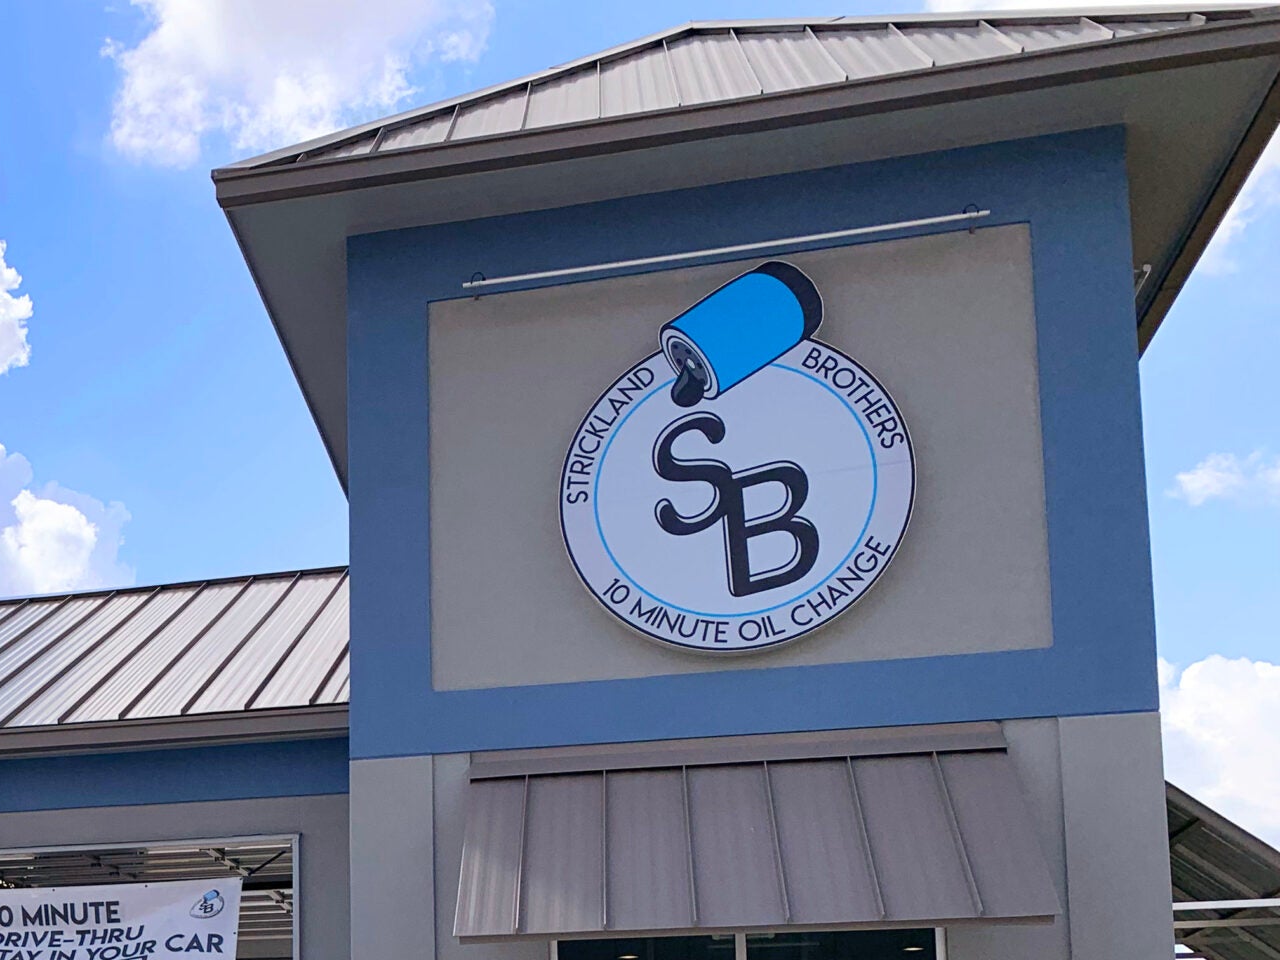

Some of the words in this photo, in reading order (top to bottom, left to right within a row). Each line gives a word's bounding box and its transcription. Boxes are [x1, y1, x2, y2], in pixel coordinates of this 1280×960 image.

[566, 366, 655, 504] STRICKLAND
[801, 346, 905, 449] BROTHERS
[602, 578, 630, 605] 10
[630, 596, 729, 643] MINUTE
[738, 614, 787, 642] OIL
[790, 535, 892, 626] CHANGE
[21, 900, 121, 926] MINUTE
[164, 933, 224, 953] CAR
